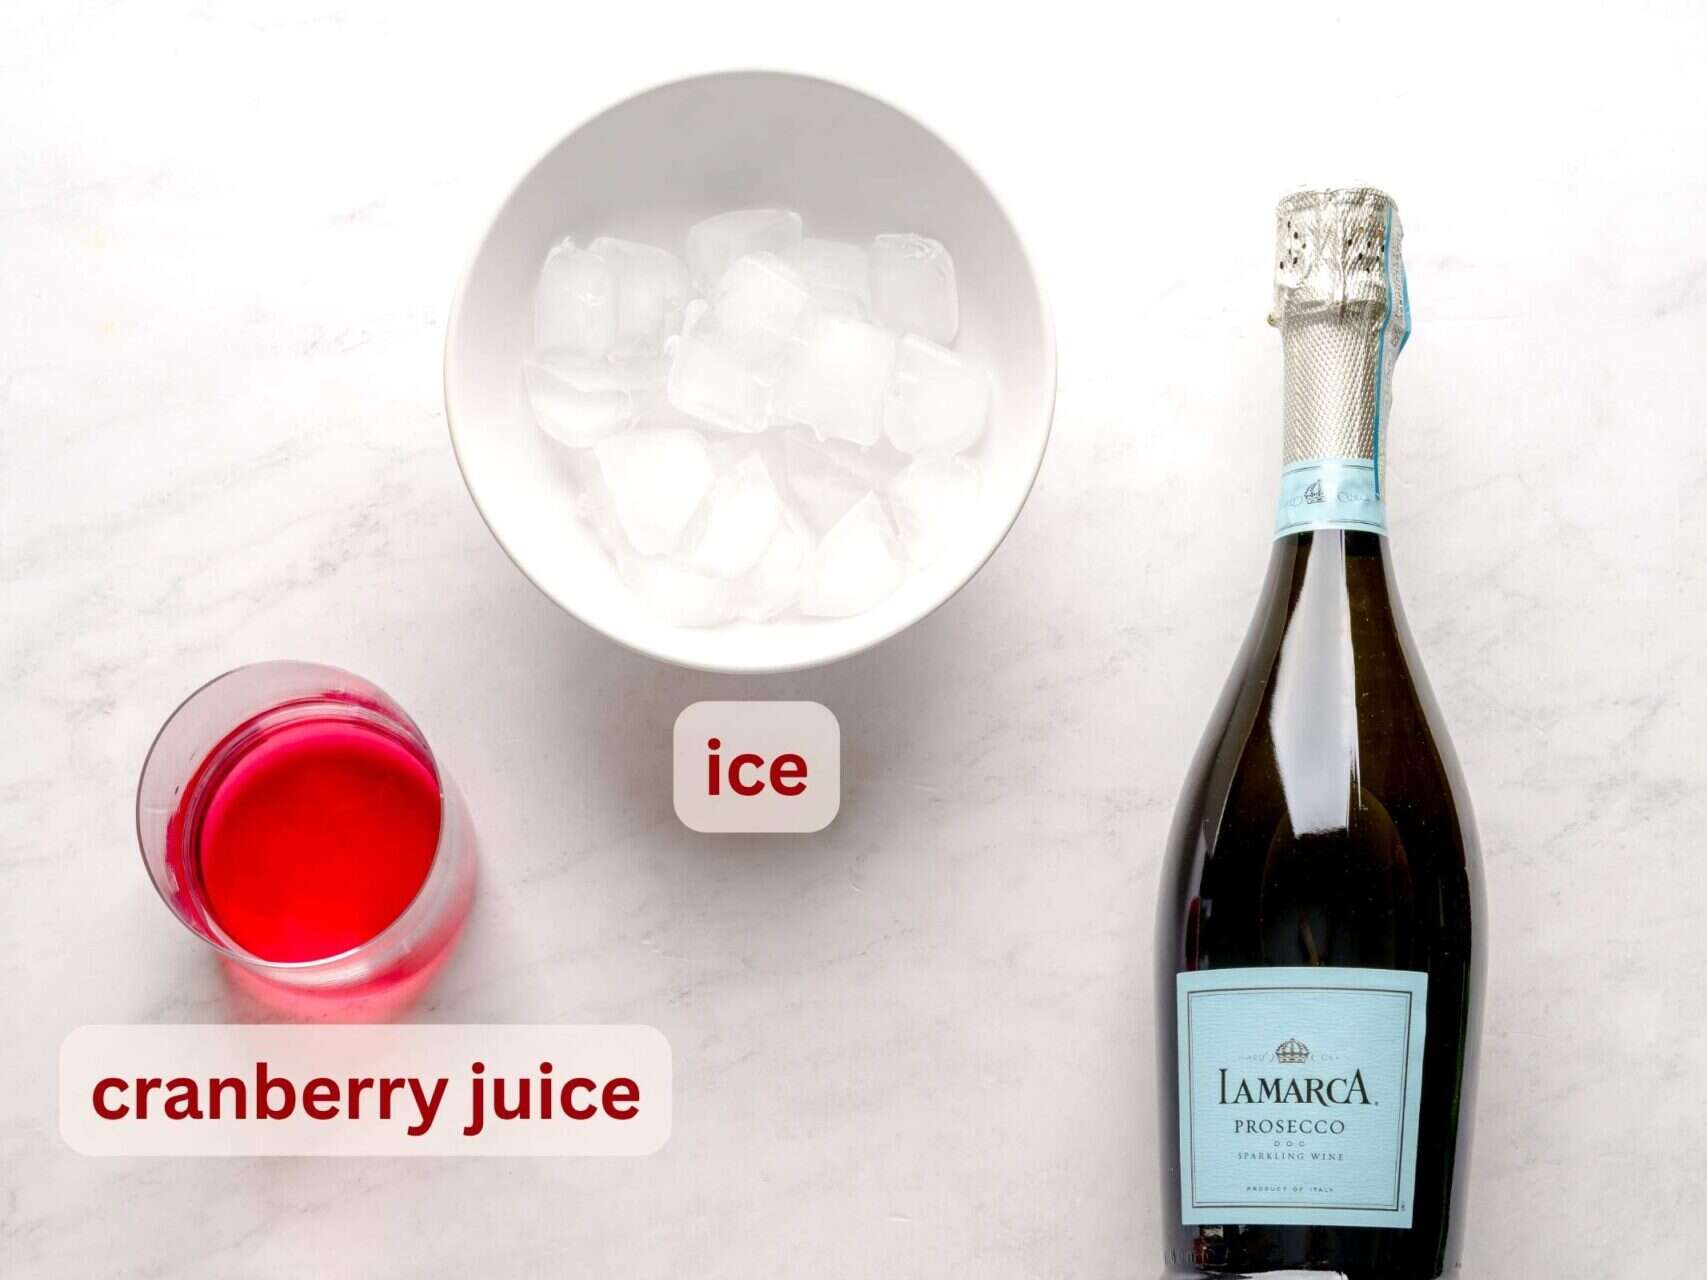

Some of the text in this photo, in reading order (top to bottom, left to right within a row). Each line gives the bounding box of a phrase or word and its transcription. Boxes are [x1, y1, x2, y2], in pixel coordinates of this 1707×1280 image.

[1234, 1119, 1345, 1135] PROSECCO
[1238, 1152, 1344, 1161] SPARKLING WINE
